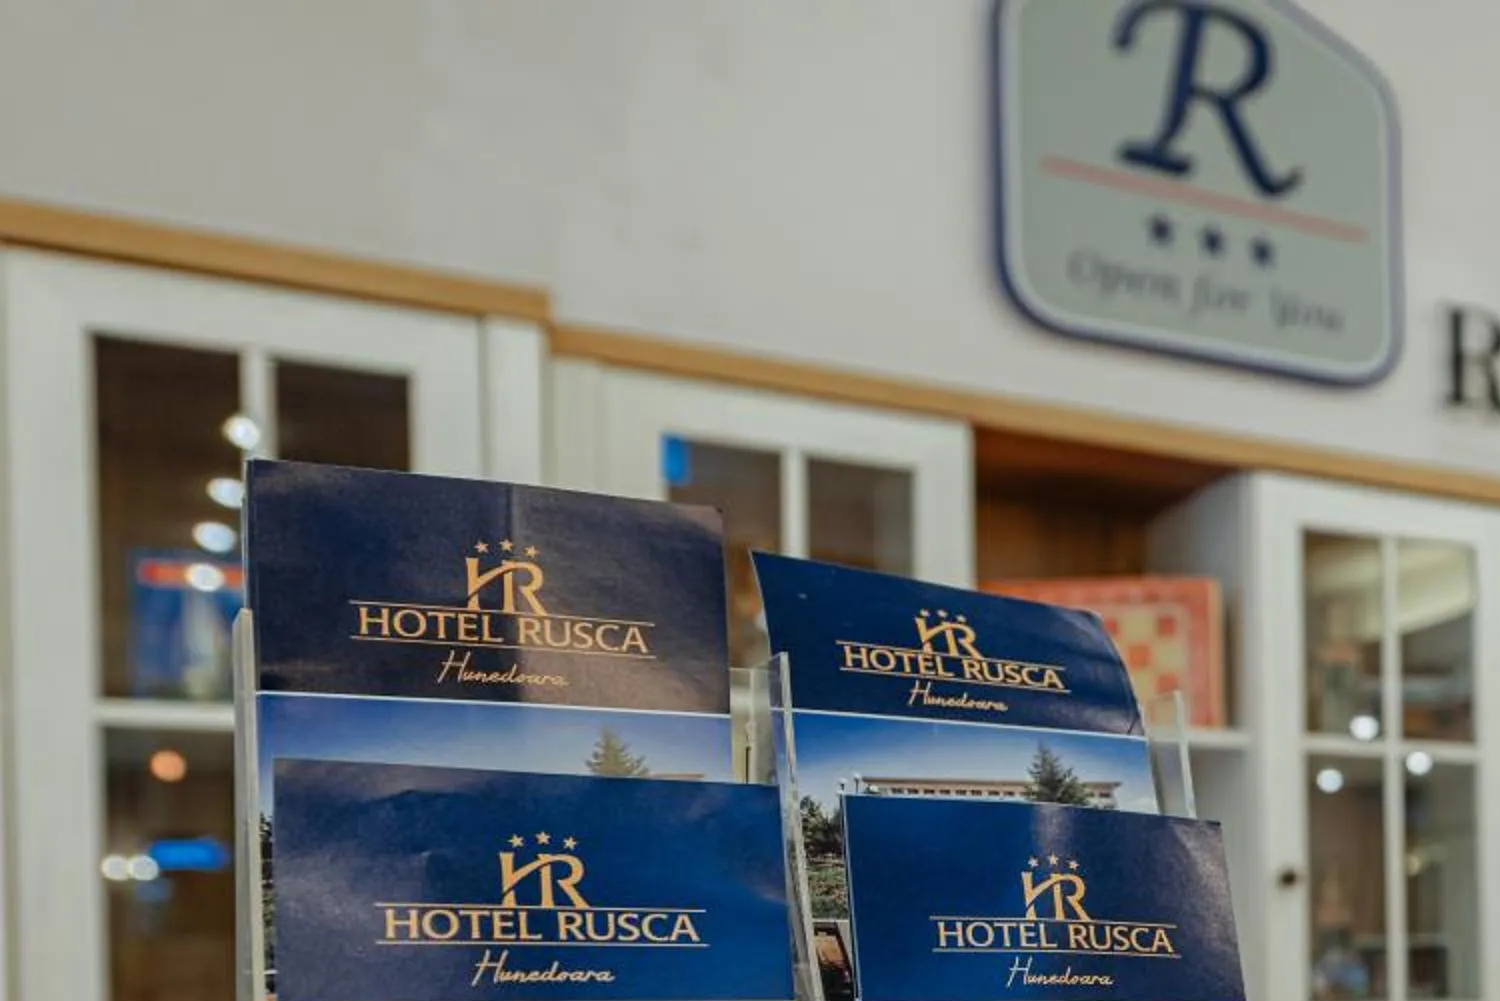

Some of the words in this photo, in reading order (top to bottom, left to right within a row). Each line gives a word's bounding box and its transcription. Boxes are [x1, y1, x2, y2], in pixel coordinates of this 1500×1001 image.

[1112, 0, 1303, 197] R
[358, 607, 504, 644] HOTEL
[518, 619, 649, 654] RUSCA
[437, 650, 571, 688] Hunedoara
[843, 645, 954, 677] HOTEL
[961, 659, 1065, 690] RUSCA
[906, 680, 1009, 712] Hunedoara
[384, 908, 542, 941] HOTEL
[557, 911, 701, 943] RUSCA
[937, 921, 1058, 948] HOTEL
[1068, 923, 1174, 953] RUSCA
[472, 949, 616, 987] Hunedoara
[1006, 956, 1114, 988] Hunedoara
